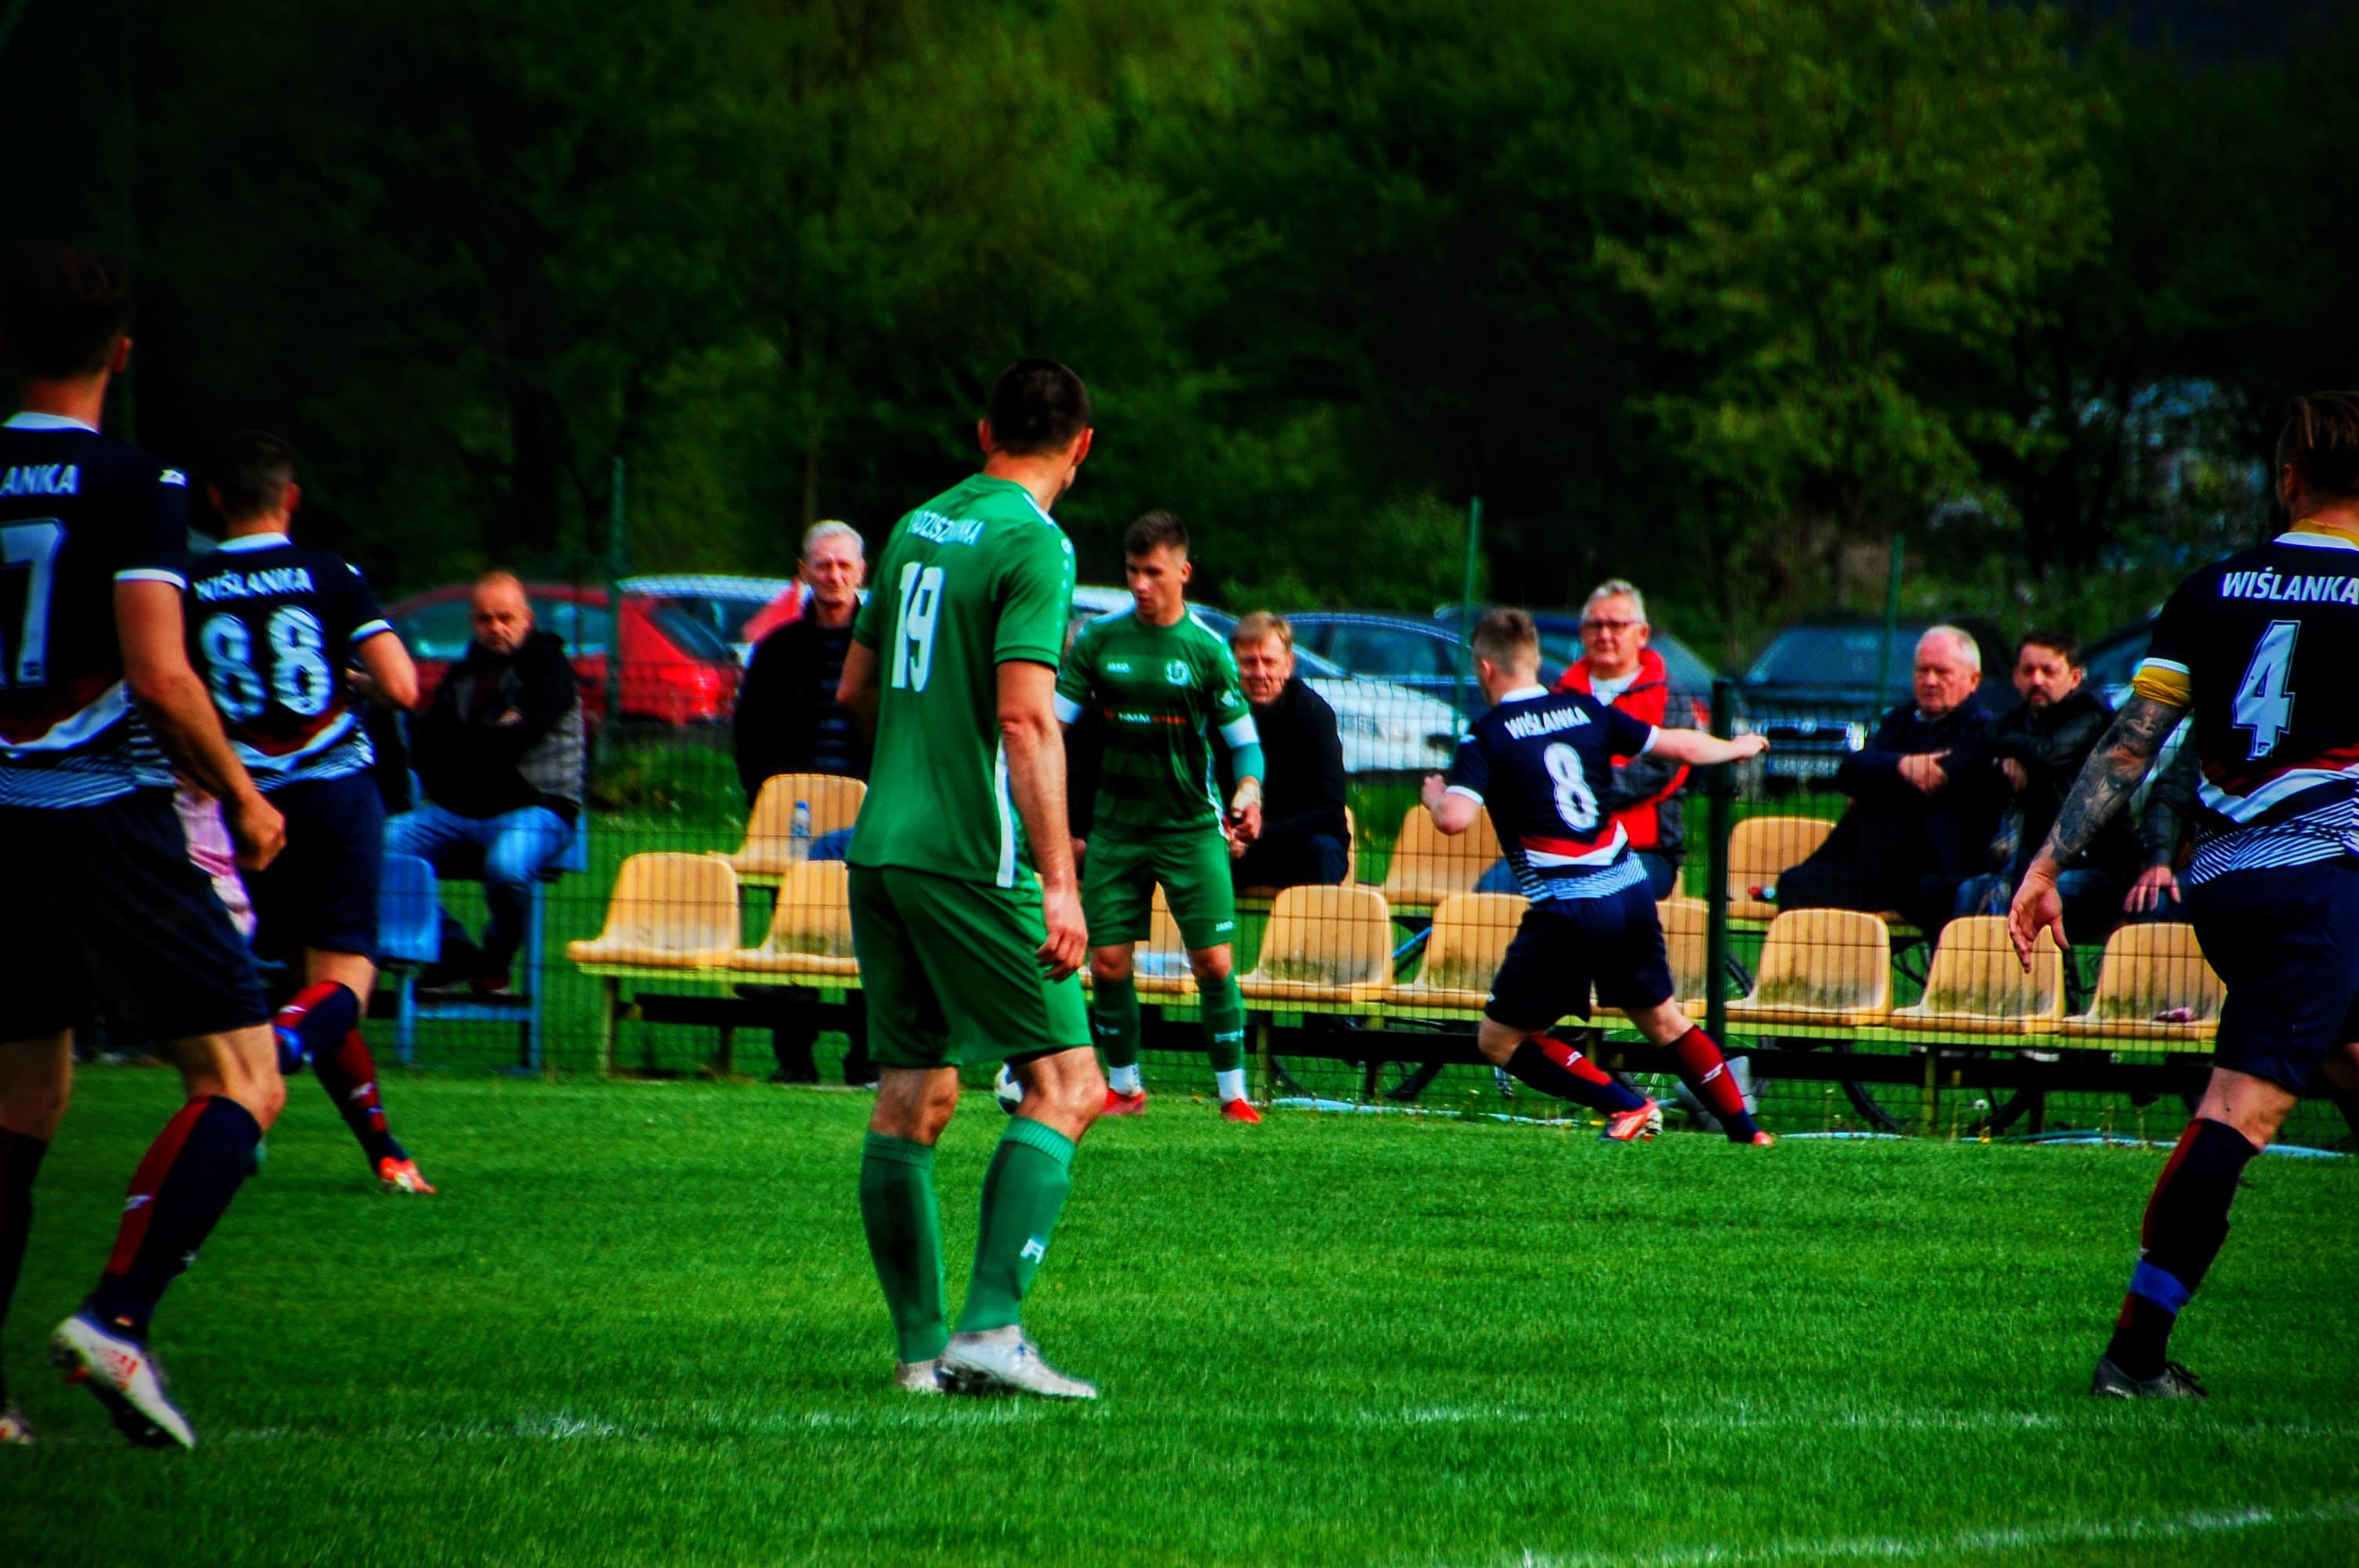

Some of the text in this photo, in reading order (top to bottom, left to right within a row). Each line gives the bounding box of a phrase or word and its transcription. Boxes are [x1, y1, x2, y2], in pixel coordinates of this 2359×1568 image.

[0, 517, 68, 691] 7
[193, 567, 315, 602] WIŚLANKA
[891, 561, 946, 693] 19
[2223, 566, 2359, 605] WIŚLANKA
[199, 604, 332, 723] 88
[2232, 619, 2301, 760] 4
[1503, 706, 1591, 739] WIŚLANKA
[1543, 742, 1600, 833] 8
